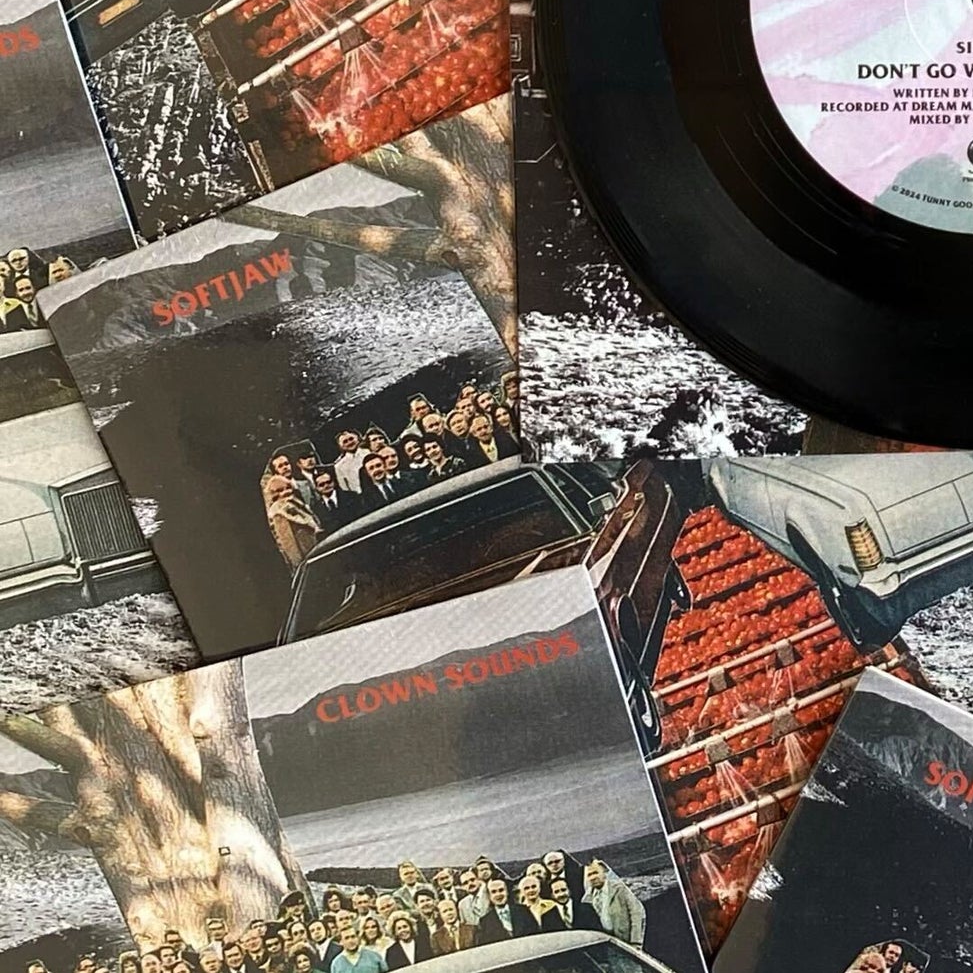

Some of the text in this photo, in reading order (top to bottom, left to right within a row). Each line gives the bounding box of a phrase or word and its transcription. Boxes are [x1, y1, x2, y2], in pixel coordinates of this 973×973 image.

[857, 63, 921, 79] DON'T
[926, 63, 956, 79] GO
[893, 88, 949, 98] WRITTEN
[953, 88, 968, 98] BY
[821, 102, 889, 112] RECORDED
[892, 101, 908, 111] AT
[912, 101, 957, 111] DREAM
[909, 114, 951, 124] MIXED
[954, 114, 970, 124] BY
[900, 187, 920, 200] 2024
[922, 194, 951, 206] FUNNY
[152, 247, 291, 326] SOFTJAW
[315, 630, 580, 723] CLOWN SOUNDS
